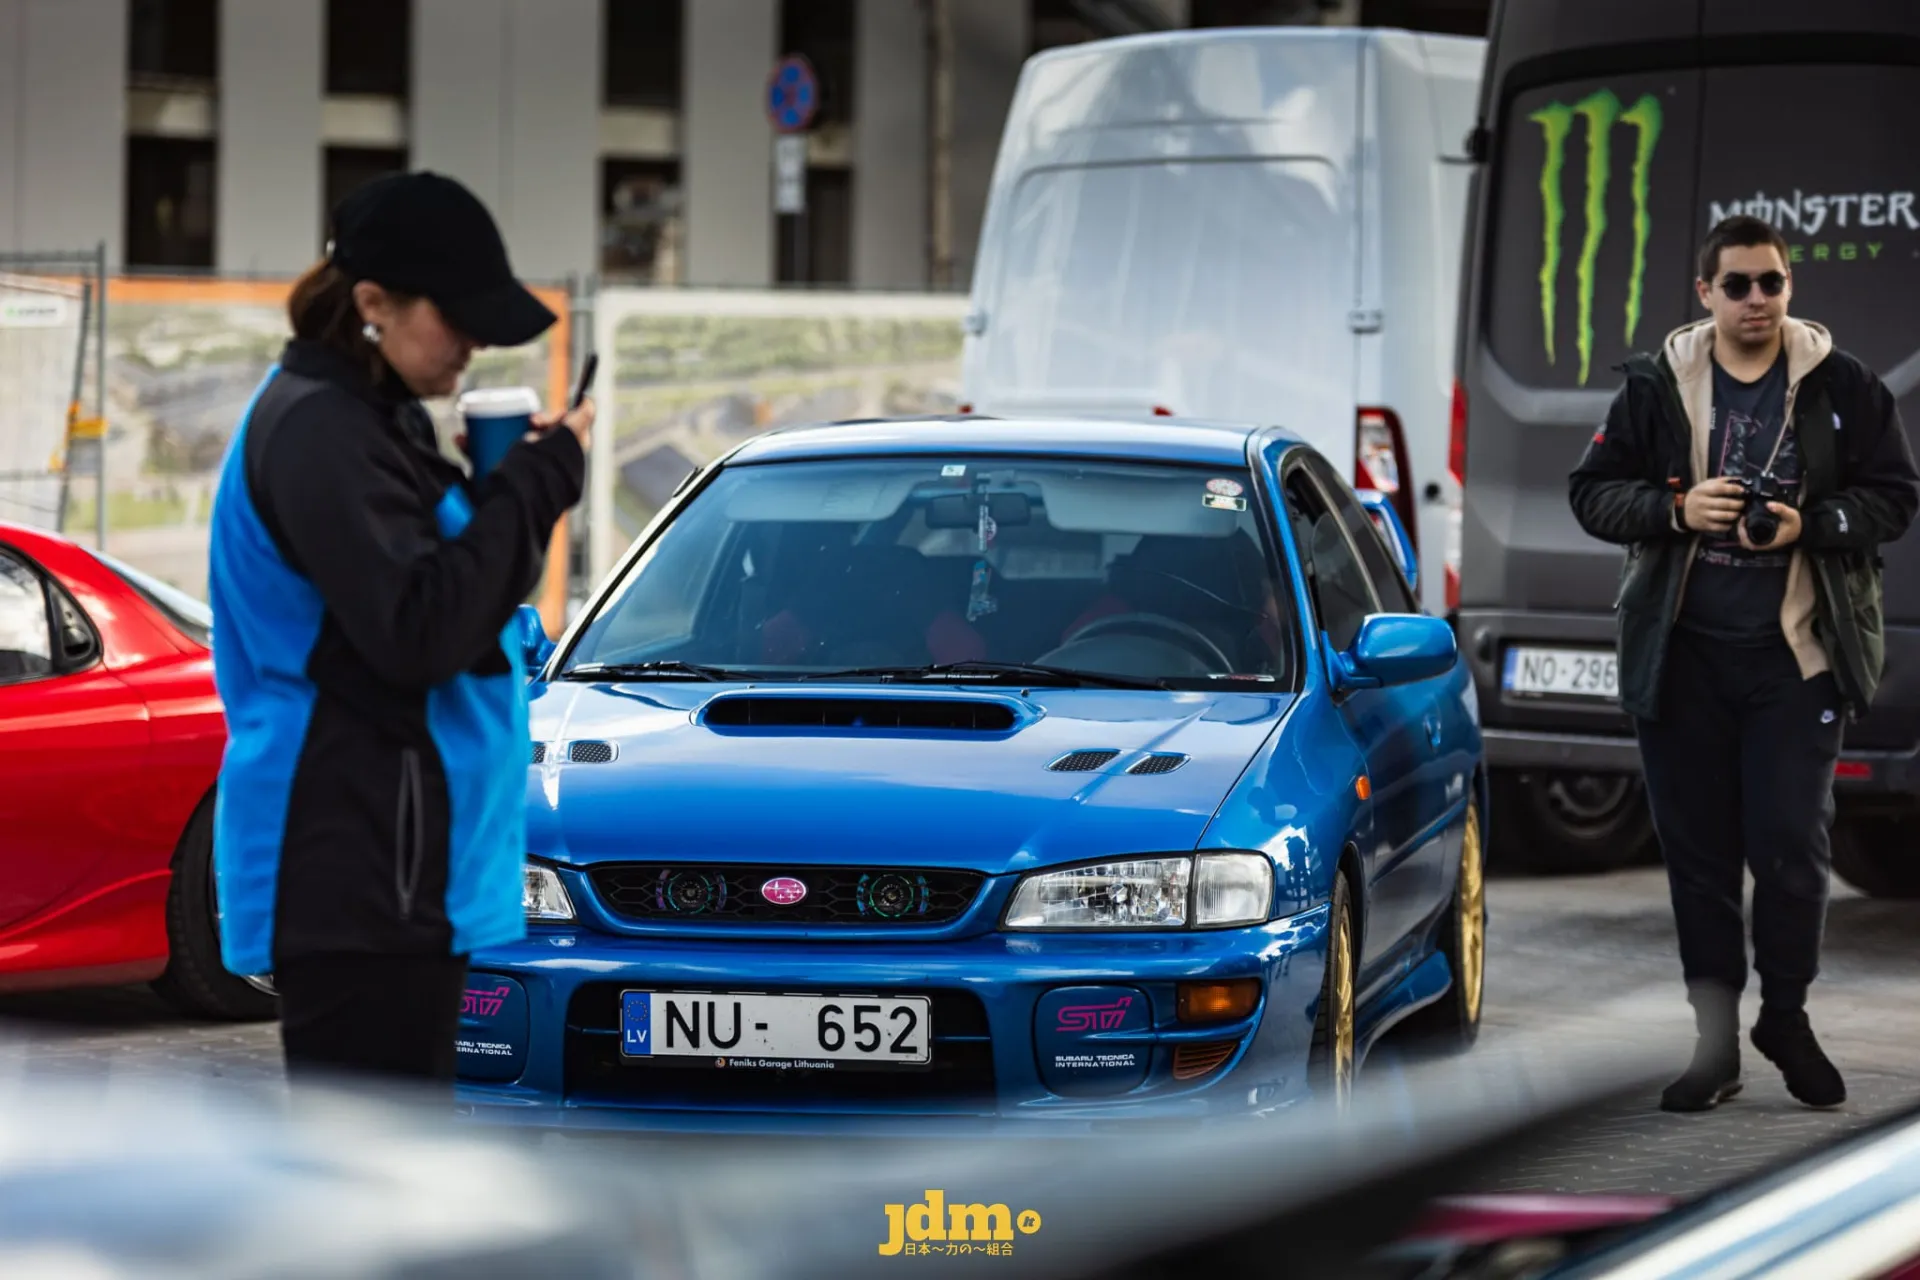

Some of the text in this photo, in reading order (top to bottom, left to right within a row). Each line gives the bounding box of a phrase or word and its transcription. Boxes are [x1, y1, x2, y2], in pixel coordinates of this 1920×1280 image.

[1789, 242, 1882, 262] ERGY
[626, 1029, 647, 1043] LV
[817, 1004, 918, 1054] 652
[729, 1058, 835, 1070] Feniks Garage Lithuania
